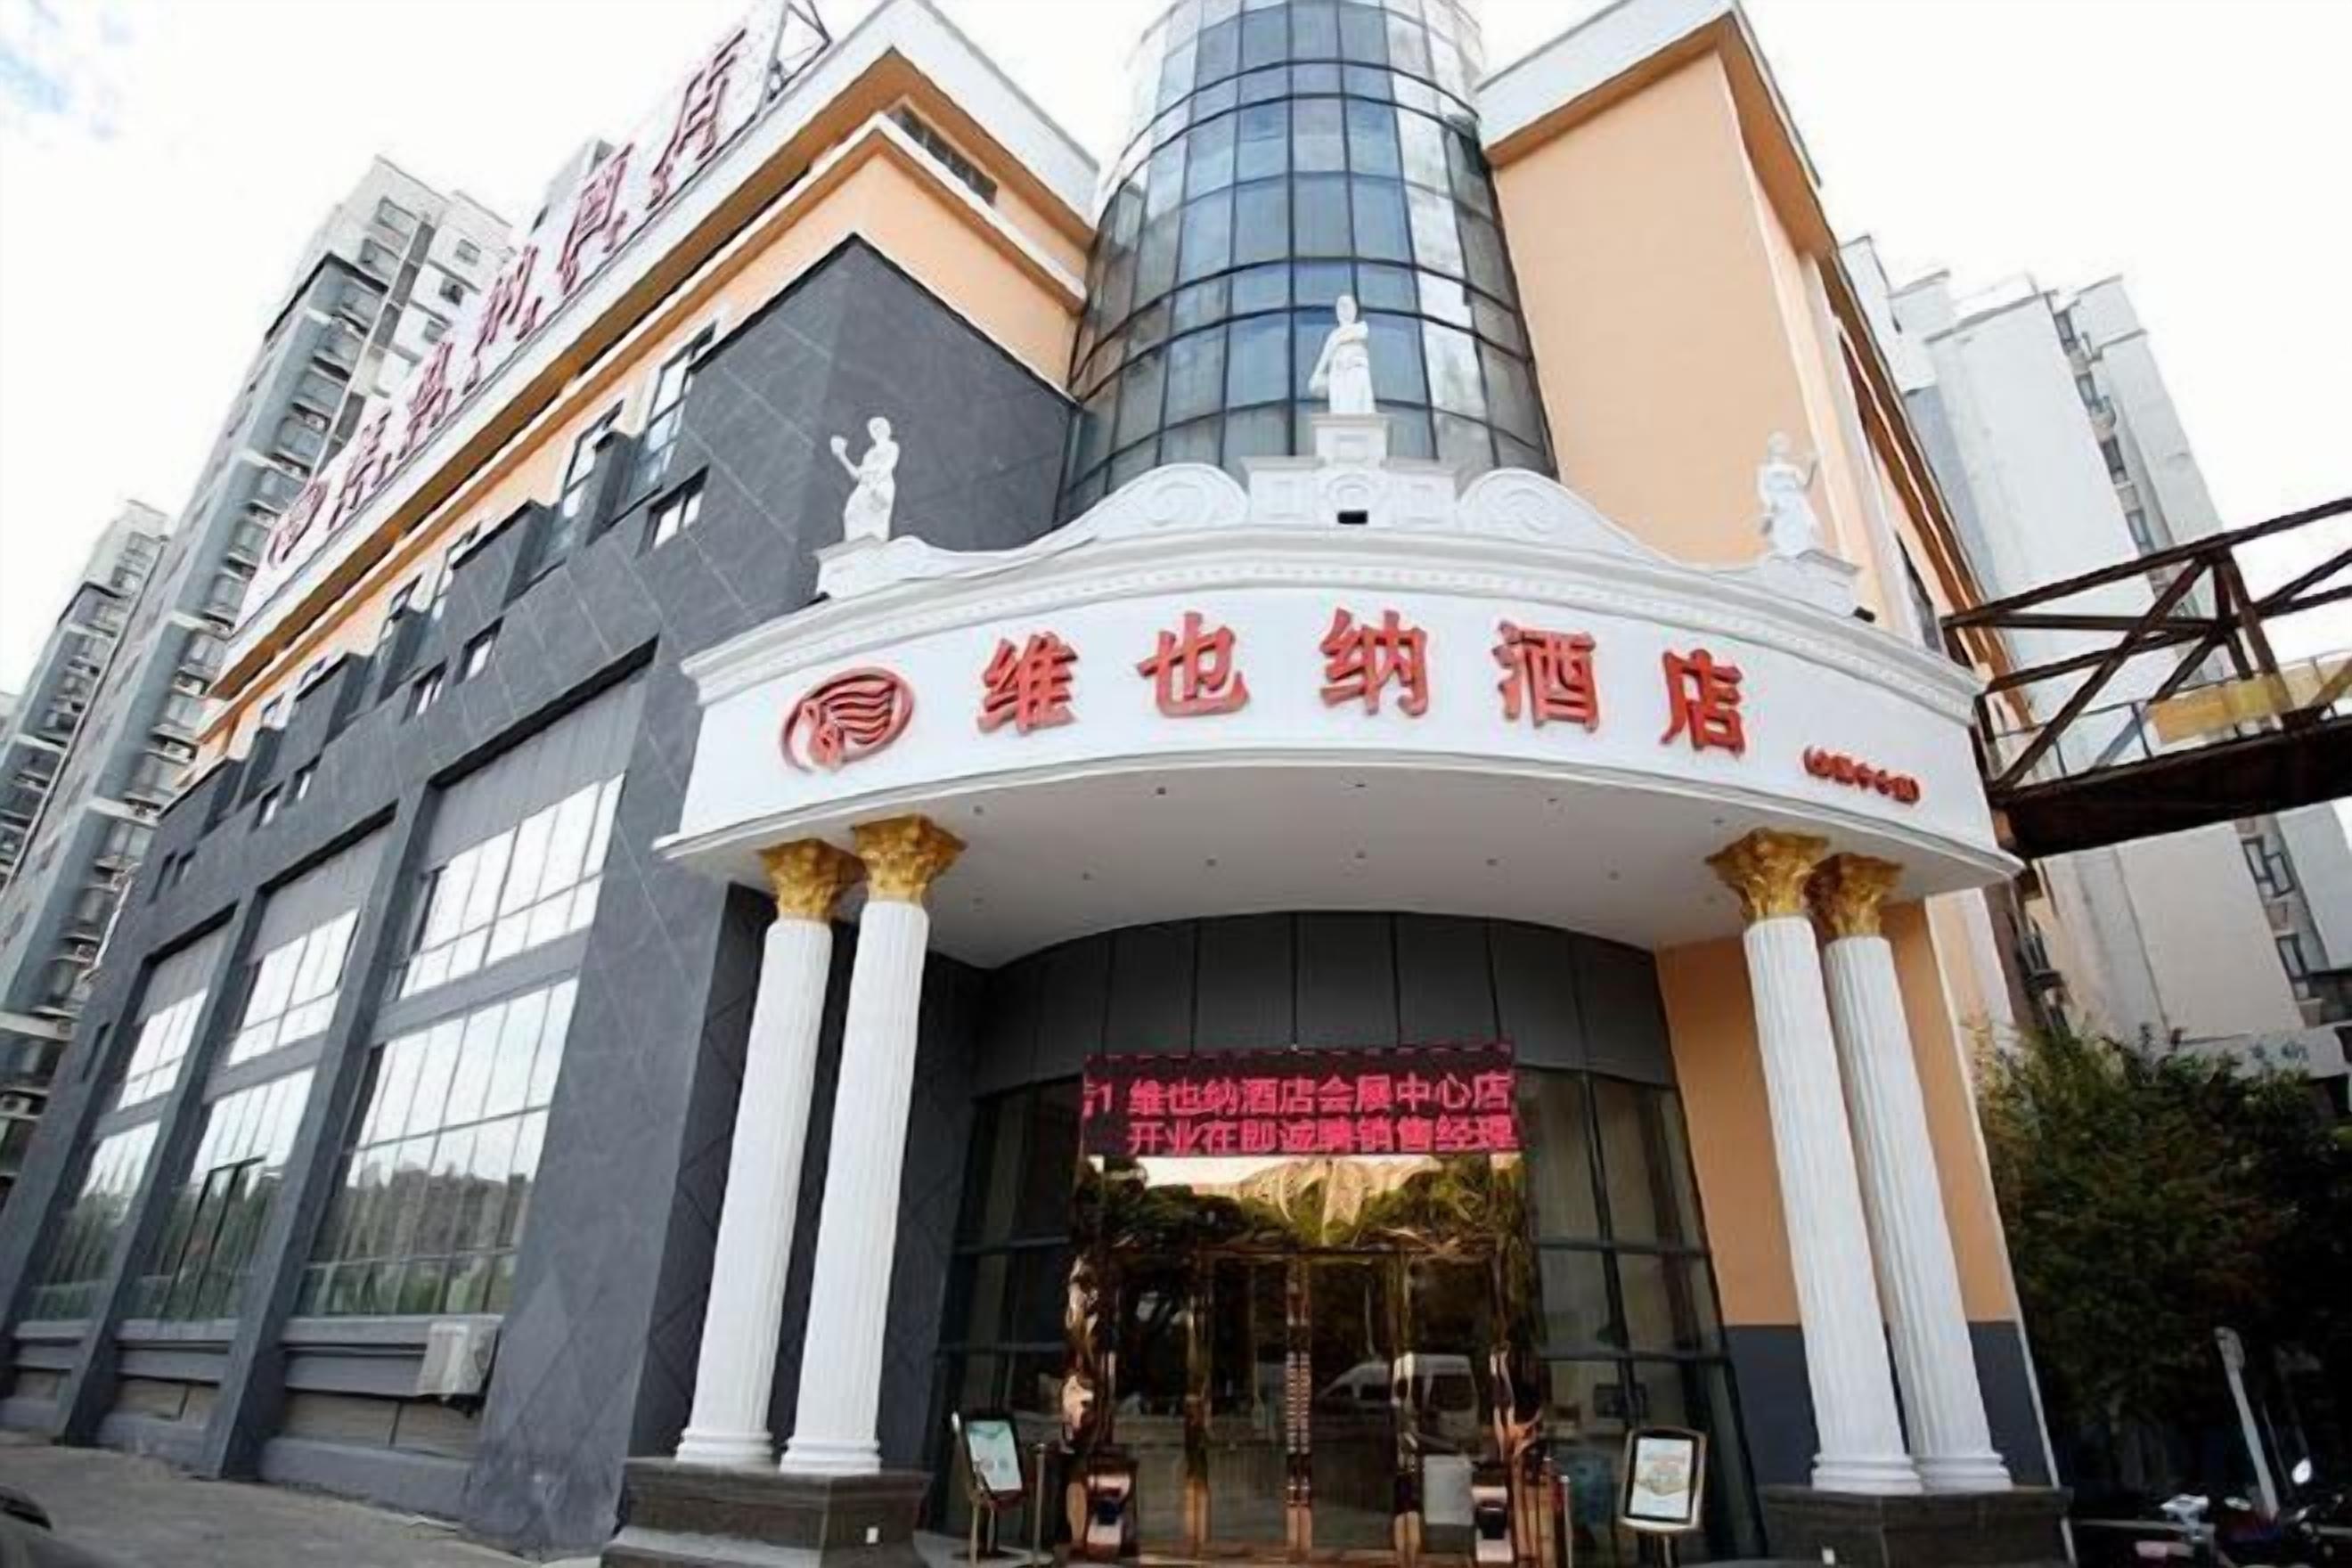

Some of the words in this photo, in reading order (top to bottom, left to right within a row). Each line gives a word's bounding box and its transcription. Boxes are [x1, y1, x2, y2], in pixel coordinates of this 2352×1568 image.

[976, 609, 1747, 755] 维也纳酒店
